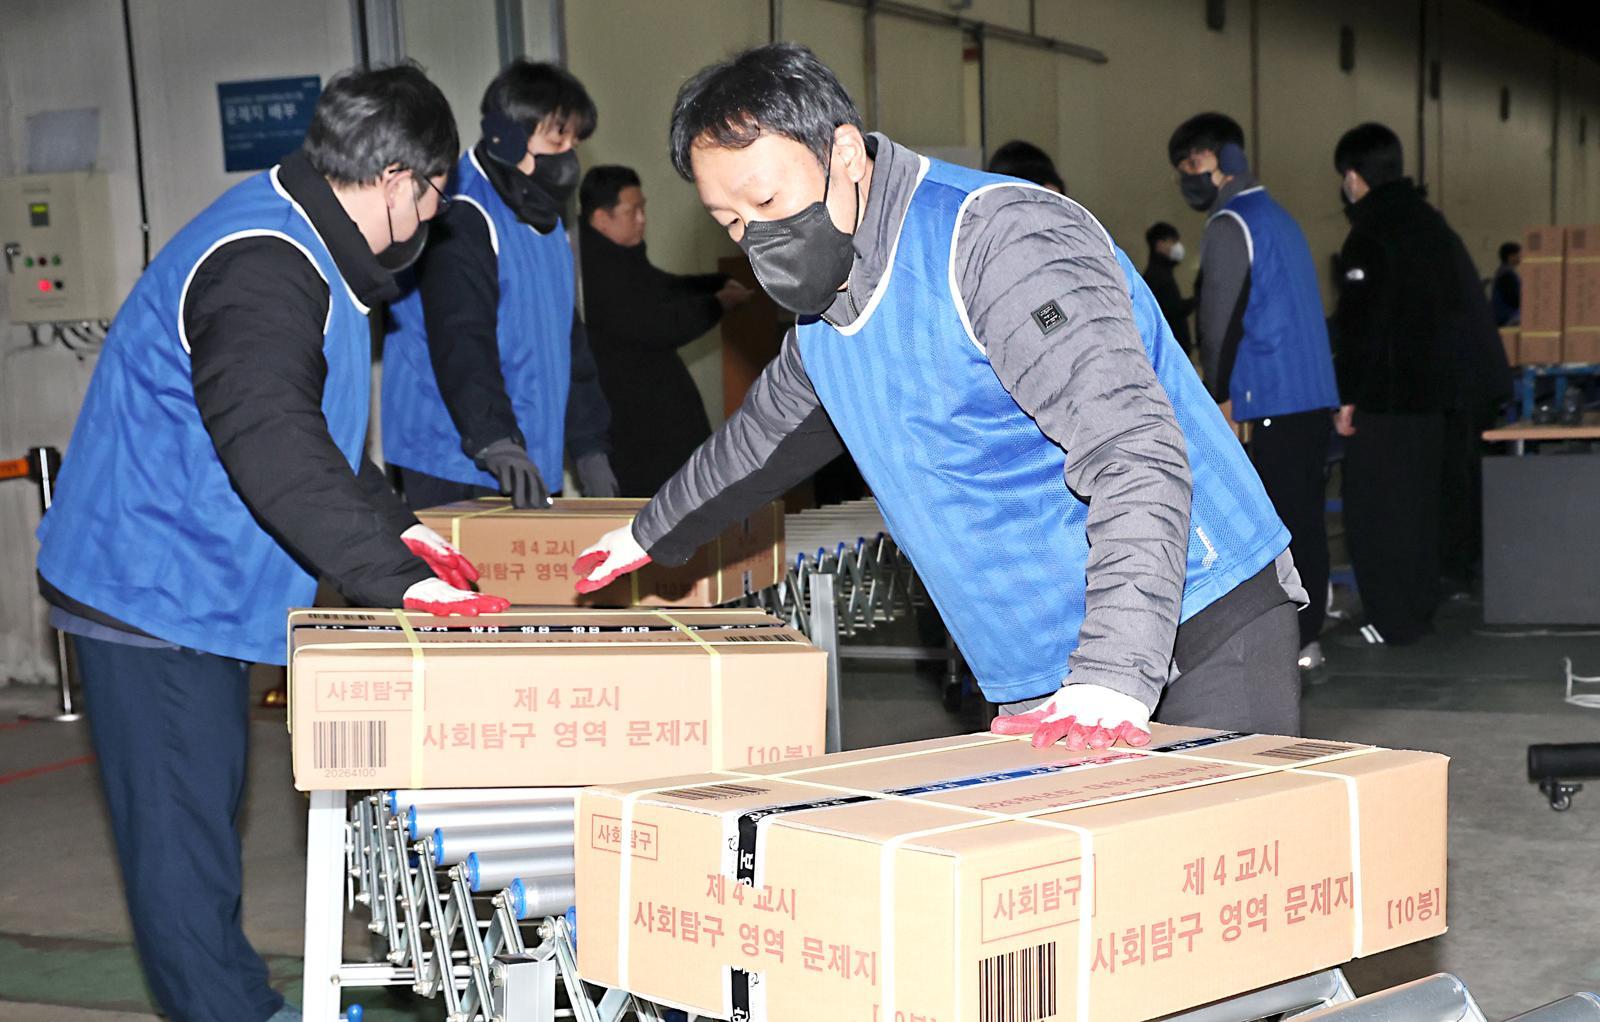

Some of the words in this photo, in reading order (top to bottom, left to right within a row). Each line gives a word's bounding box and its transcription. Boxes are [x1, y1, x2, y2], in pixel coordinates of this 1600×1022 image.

[511, 540, 526, 557] 제
[530, 541, 540, 555] 4
[544, 540, 576, 557] 교시
[477, 563, 526, 581] 회탐구
[535, 563, 569, 581] 영역
[327, 680, 413, 702] 사회탐구
[514, 687, 537, 712] 제
[547, 688, 561, 709] 4
[570, 687, 620, 711] 교시
[423, 722, 536, 750] 사회탐구
[553, 720, 608, 749] 영역
[626, 719, 708, 748] 문제지
[1182, 857, 1205, 896] 제
[1213, 855, 1227, 886] 4
[1235, 840, 1279, 882] 교시
[706, 873, 726, 905] 제
[732, 882, 745, 906] 4
[753, 885, 797, 921] 교시
[993, 875, 1082, 921] 사회탐구
[1091, 912, 1204, 974] 사회탐구
[1219, 893, 1268, 942] 영역
[1284, 872, 1354, 925] 문제지
[633, 901, 725, 948] 사회탐구
[738, 922, 785, 964] 영역
[801, 937, 877, 987] 문제지
